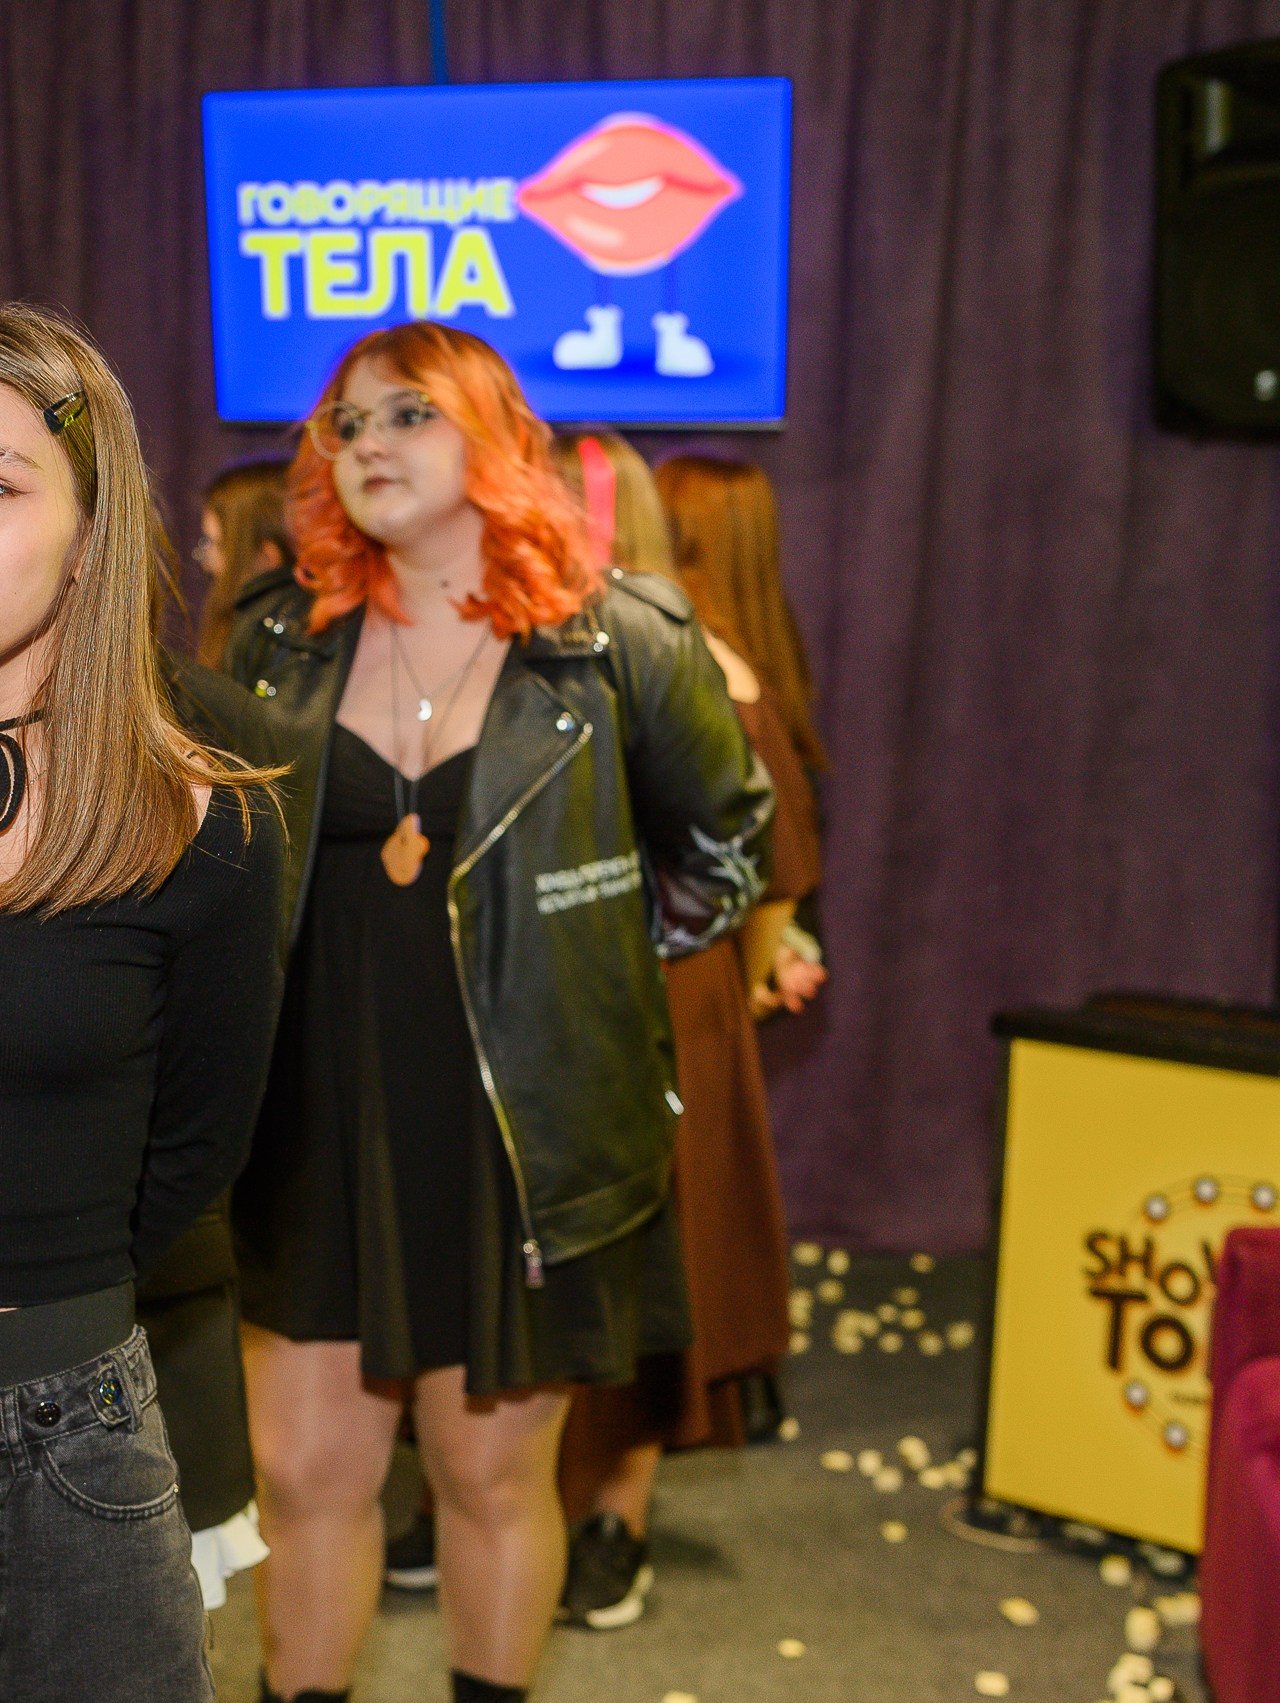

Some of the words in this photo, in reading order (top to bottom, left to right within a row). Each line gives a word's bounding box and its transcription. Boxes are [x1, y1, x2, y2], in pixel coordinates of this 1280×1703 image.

[238, 180, 517, 225] ГОВОРЯЩИЕ
[240, 229, 515, 319] ТЕЛА
[1089, 1287, 1200, 1374] TO
